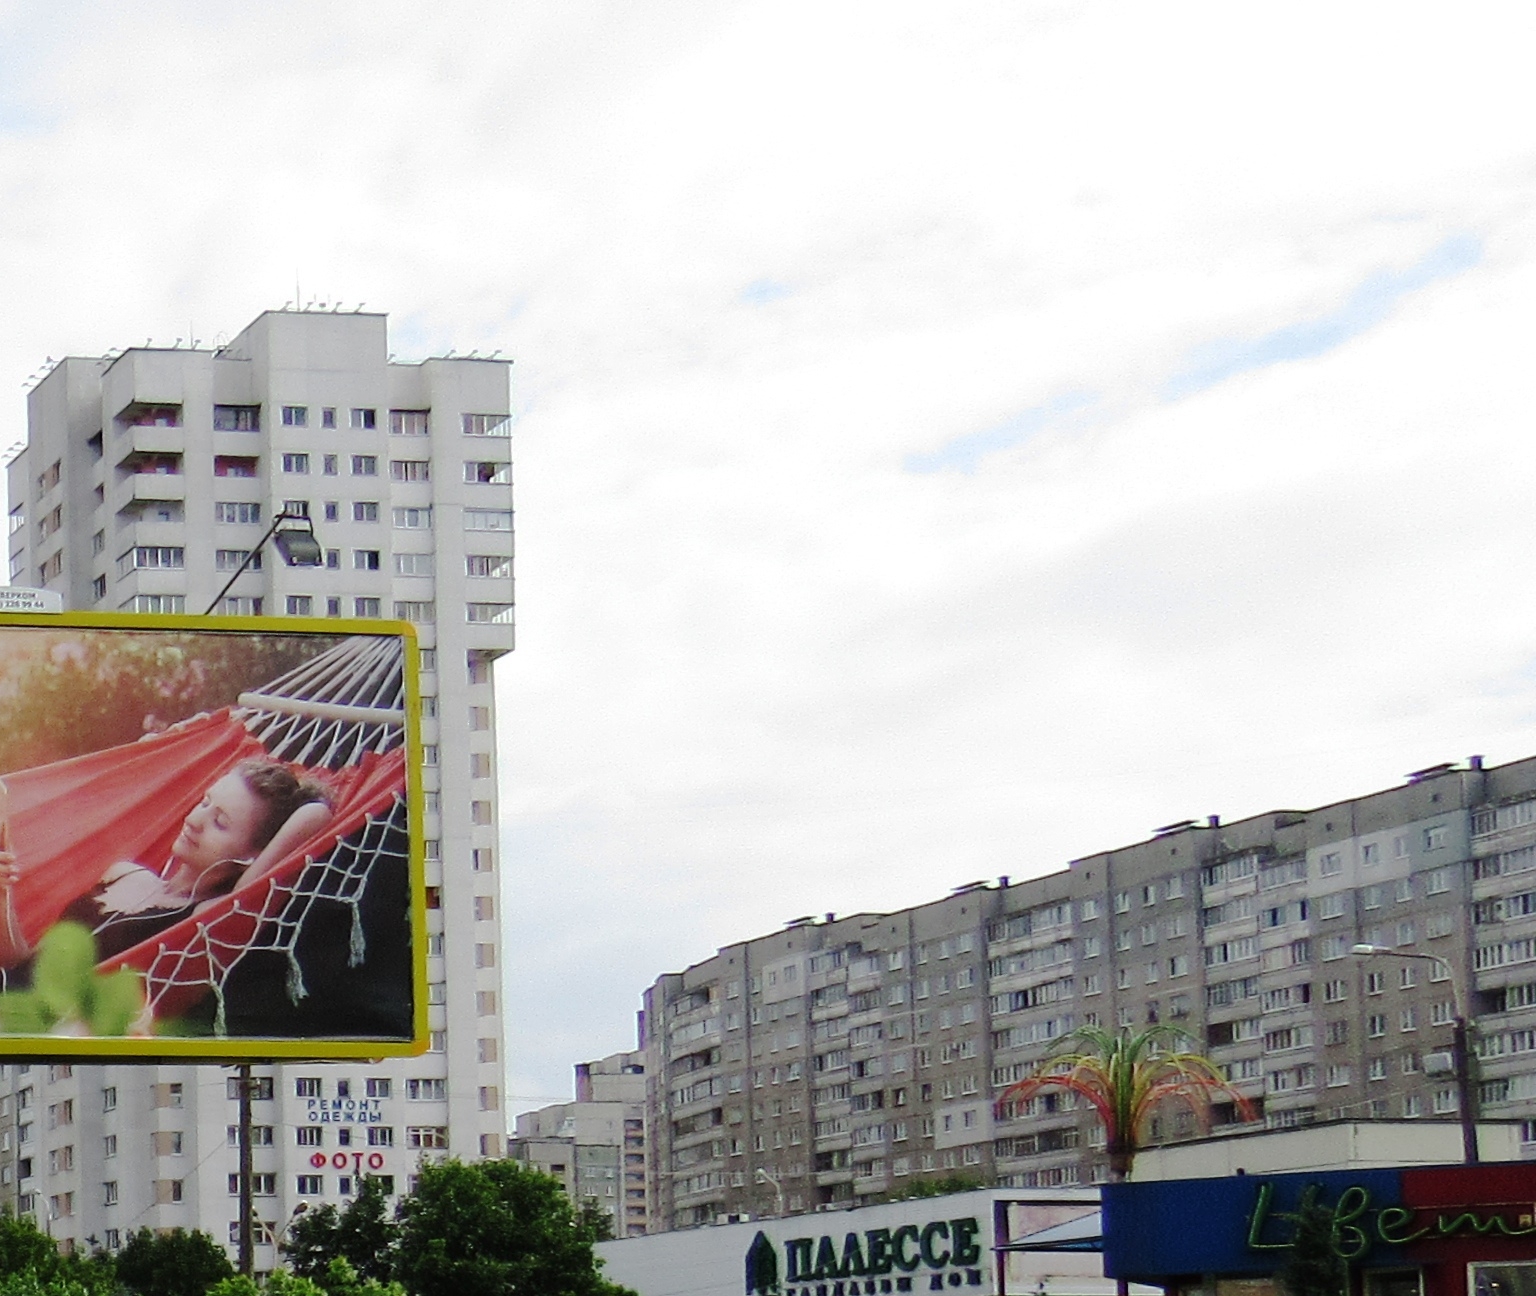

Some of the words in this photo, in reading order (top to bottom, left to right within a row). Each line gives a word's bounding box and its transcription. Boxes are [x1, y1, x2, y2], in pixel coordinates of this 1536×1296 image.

[307, 1099, 381, 1110] РЕМОНТ
[308, 1111, 382, 1122] ОДЕЖДЫ
[310, 1152, 384, 1171] ФОТО
[783, 1217, 982, 1283] ПАЛЕССЕ
